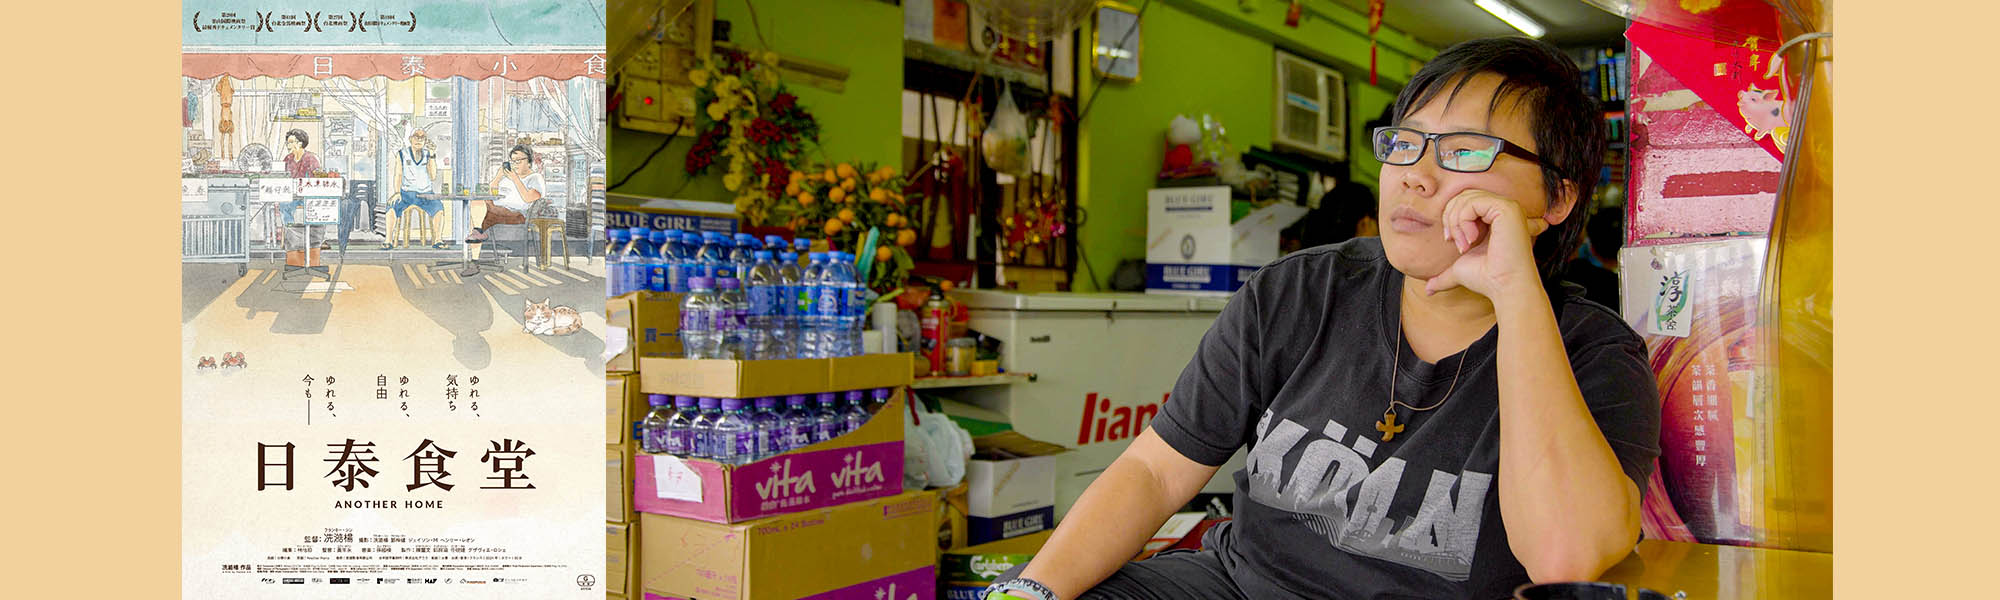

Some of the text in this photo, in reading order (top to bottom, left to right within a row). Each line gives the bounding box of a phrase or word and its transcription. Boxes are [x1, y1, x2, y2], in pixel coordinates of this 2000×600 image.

[653, 216, 695, 230] GIRL
[325, 375, 336, 418] ゆれる、
[376, 374, 388, 399] 自由
[399, 375, 410, 418] ゆれる、
[446, 374, 459, 411] 気持ち
[469, 375, 480, 418] ゆれる、
[257, 438, 537, 493] 日泰食堂
[755, 458, 816, 499] vita
[831, 450, 884, 488] vita
[334, 500, 443, 509] ANOTHER HOME
